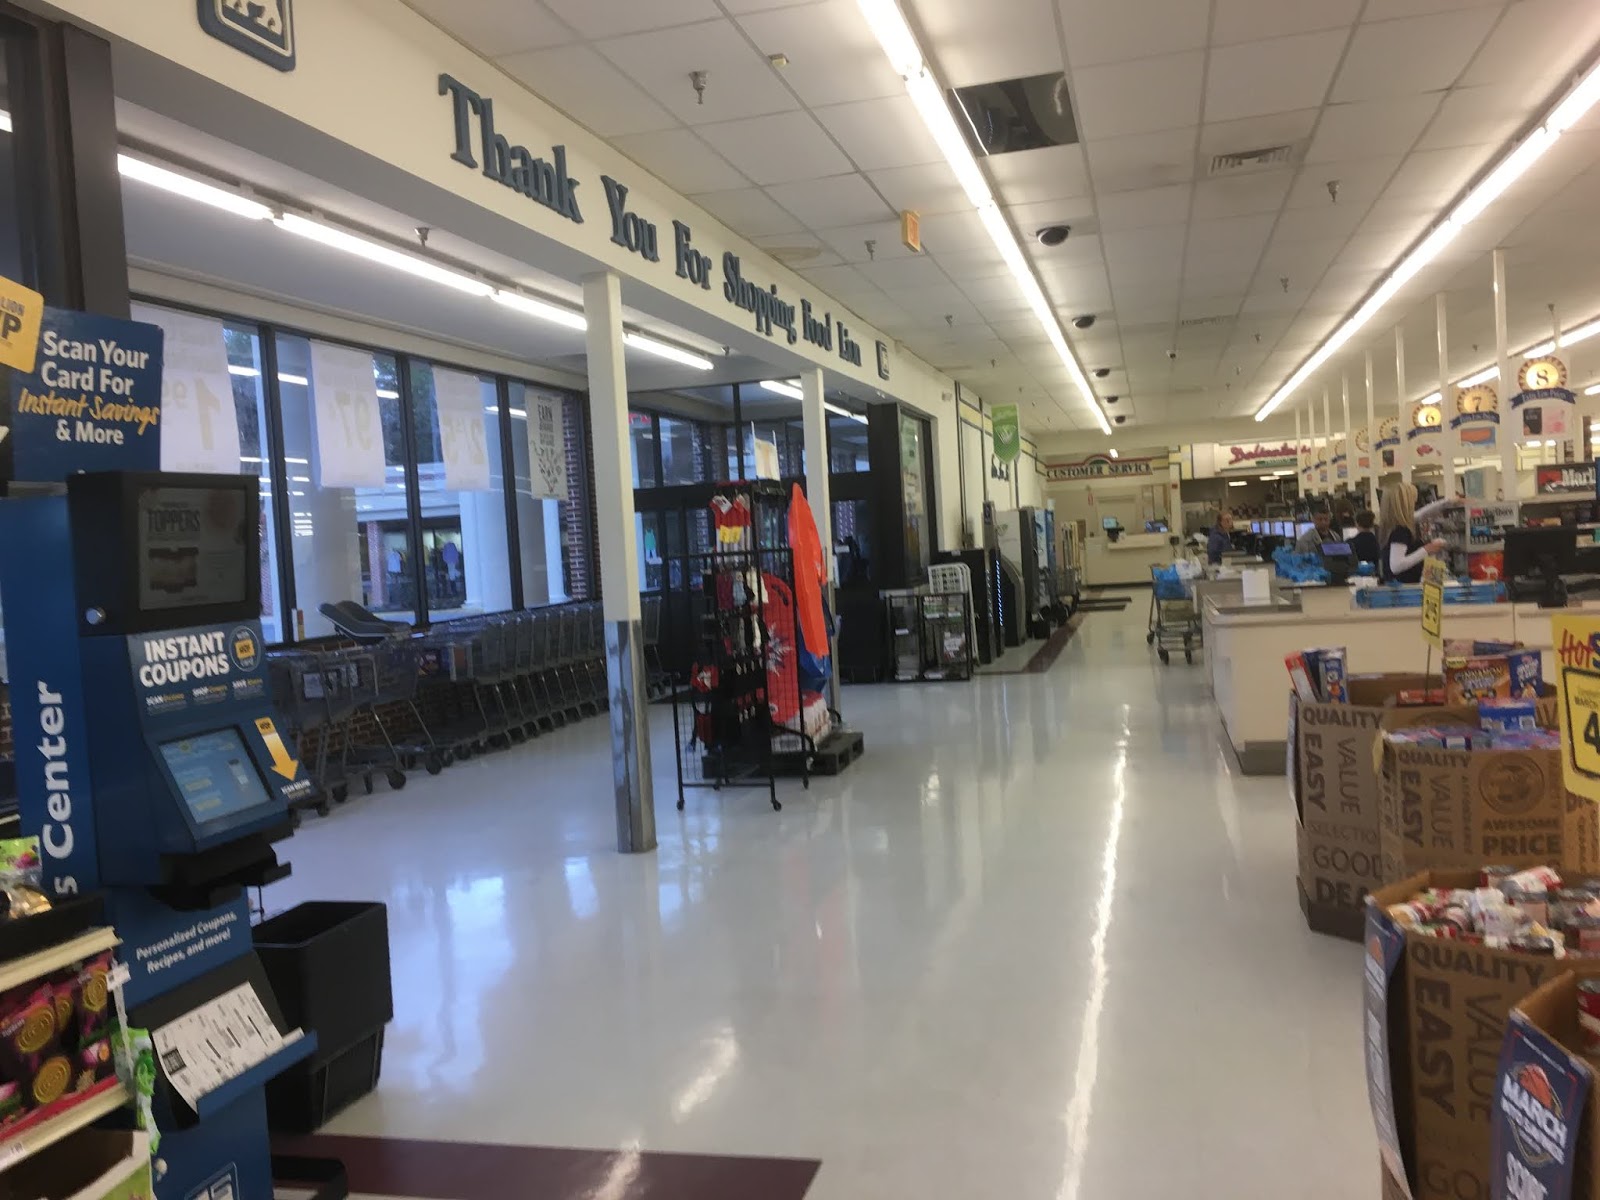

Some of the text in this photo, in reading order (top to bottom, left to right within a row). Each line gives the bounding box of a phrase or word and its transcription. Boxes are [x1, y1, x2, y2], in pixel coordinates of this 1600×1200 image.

[438, 73, 862, 368] Thank You For Shopping Food Lion
[43, 331, 149, 369] Scan Your
[41, 361, 135, 396] Card For
[1536, 369, 1549, 387] 8
[17, 387, 160, 436] Instant Savings
[1472, 396, 1482, 412] 7
[56, 418, 124, 445] & More
[1046, 462, 1153, 479] CUSTOMER SERVICE
[143, 631, 225, 663] INSTANT
[140, 653, 231, 688] COUPONS
[1303, 707, 1384, 730] QUALITY
[36, 679, 75, 859] Center
[1303, 732, 1328, 813] EASY
[1337, 738, 1362, 815] VALUE
[1399, 750, 1472, 769] QUALITY
[1400, 770, 1425, 849] EASY
[1431, 774, 1454, 850] VALUE
[1482, 834, 1562, 858] PRICE
[136, 924, 197, 960] Personalized
[186, 937, 205, 957] and
[1411, 941, 1545, 985] QUALITY
[1414, 976, 1456, 1119] EASY
